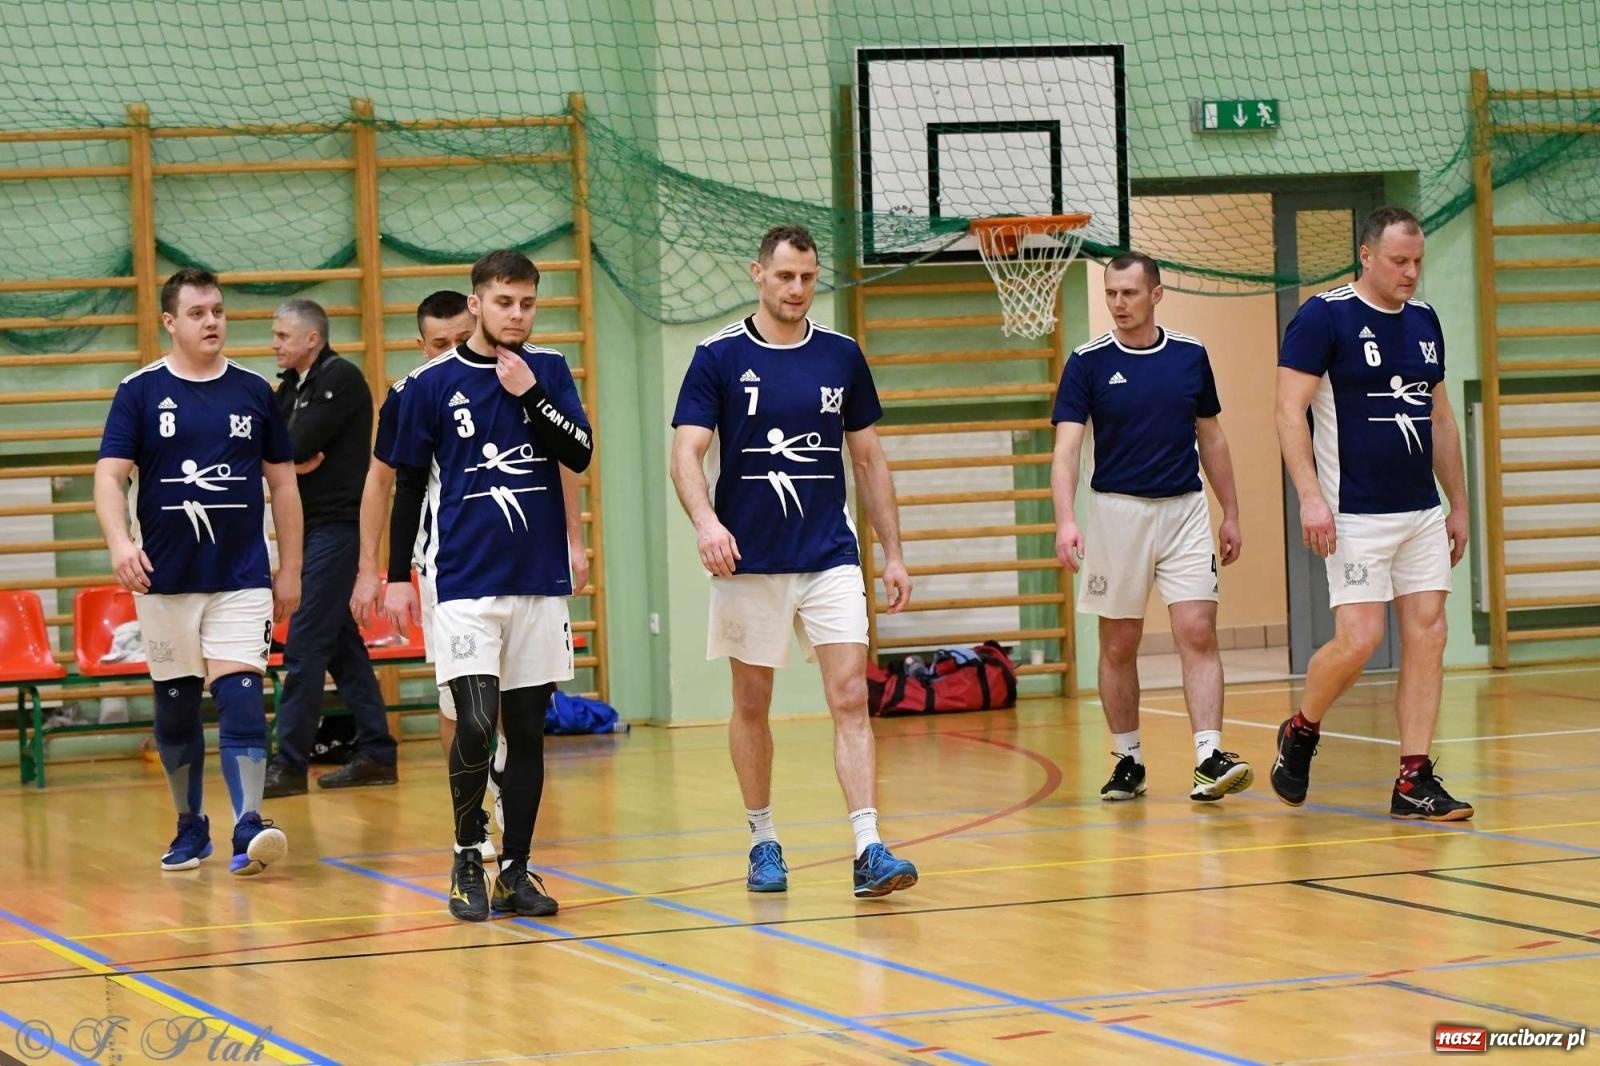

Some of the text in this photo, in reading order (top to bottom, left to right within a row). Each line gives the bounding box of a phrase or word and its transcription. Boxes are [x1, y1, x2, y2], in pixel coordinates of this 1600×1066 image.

[1363, 341, 1382, 367] 6
[744, 386, 759, 416] 7
[159, 411, 176, 438] 8
[453, 408, 475, 438] 3
[541, 403, 565, 427] CAN
[263, 619, 272, 644] 8
